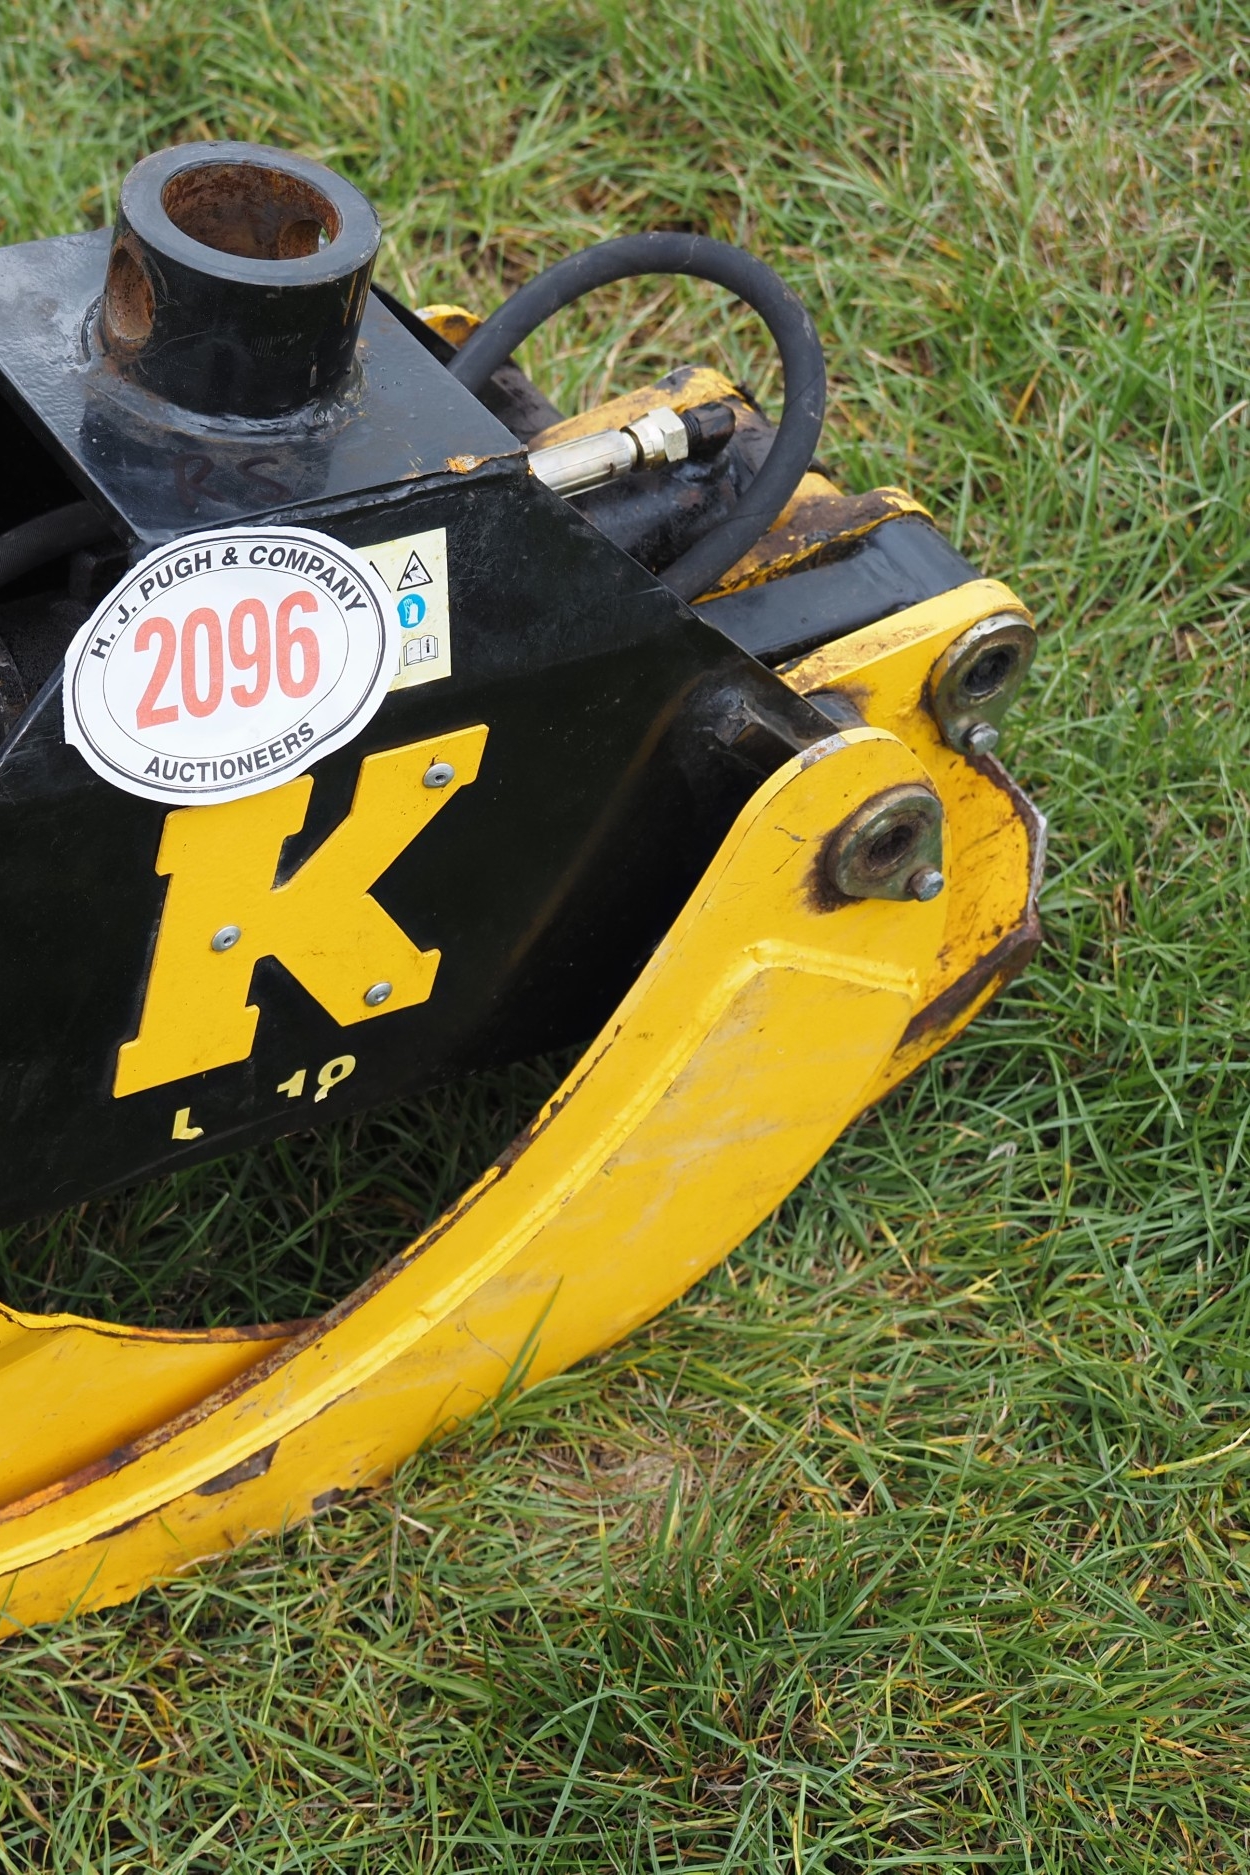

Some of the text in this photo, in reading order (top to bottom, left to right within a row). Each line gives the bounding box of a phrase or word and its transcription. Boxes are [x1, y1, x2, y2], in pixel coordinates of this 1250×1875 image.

[90, 545, 368, 660] H. J. PUGH & COMPANY
[133, 590, 321, 731] 2096
[143, 722, 316, 783] AUCTIONEERS
[112, 723, 490, 1099] K
